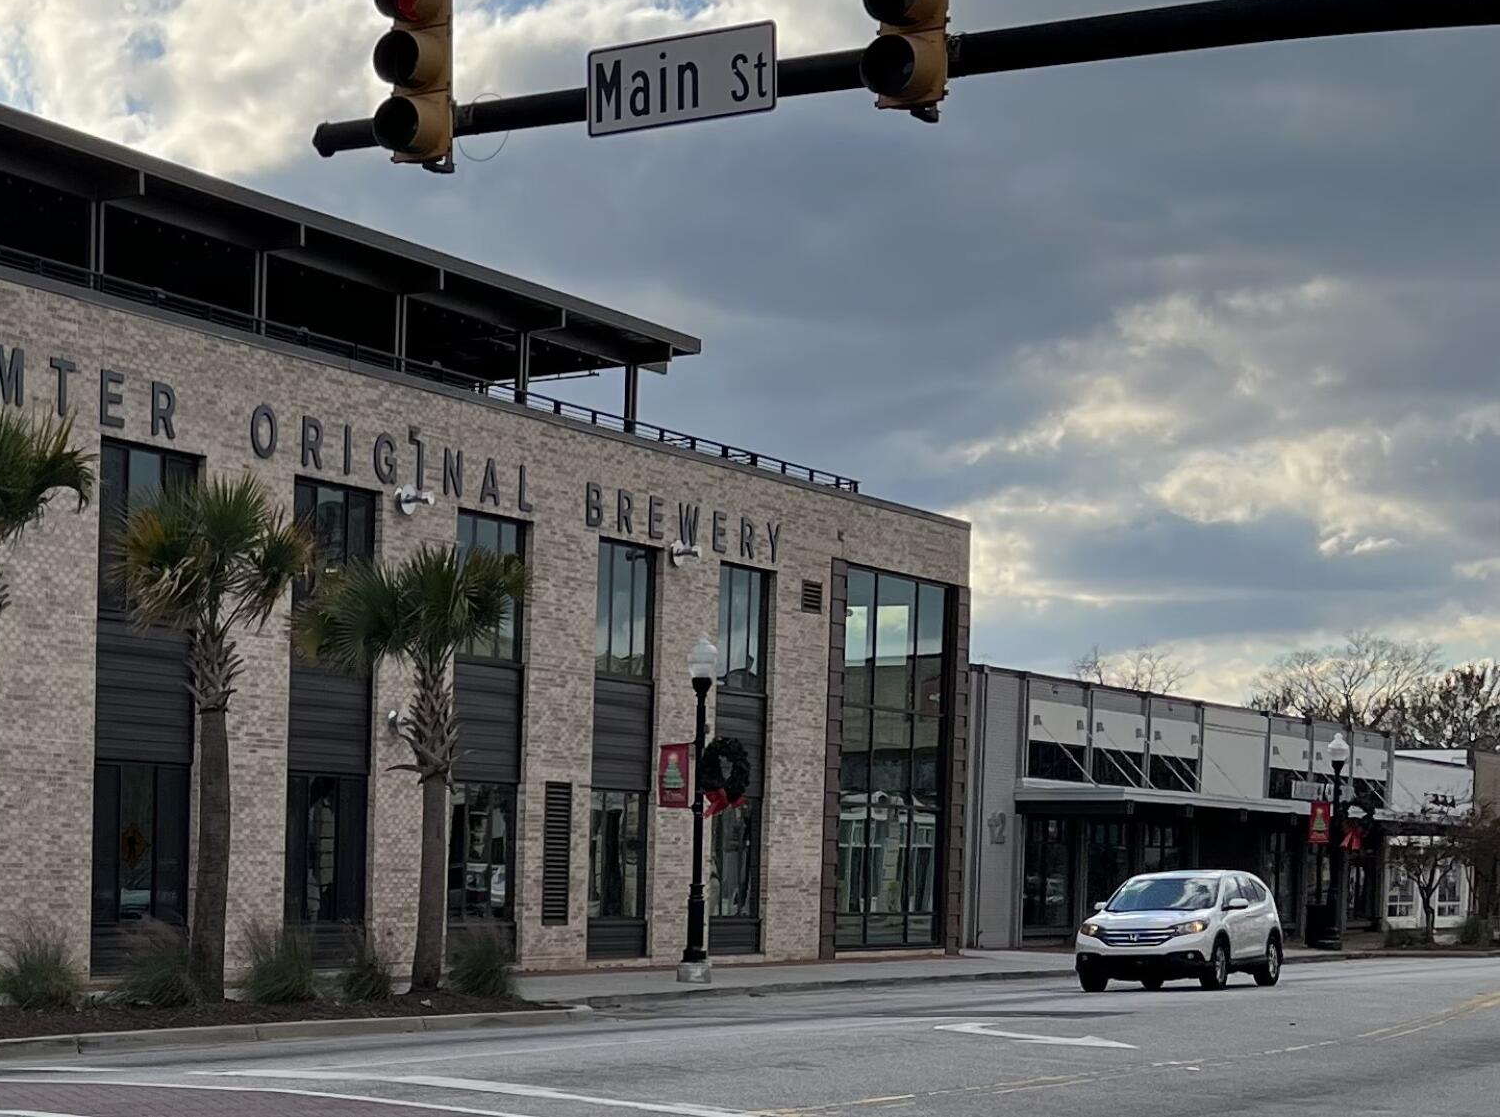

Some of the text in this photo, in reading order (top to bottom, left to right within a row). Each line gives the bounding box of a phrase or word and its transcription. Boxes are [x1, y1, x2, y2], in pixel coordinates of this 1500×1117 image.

[596, 52, 767, 123] Main St
[250, 403, 533, 513] ORIGINAL
[585, 482, 781, 564] BREWERY
